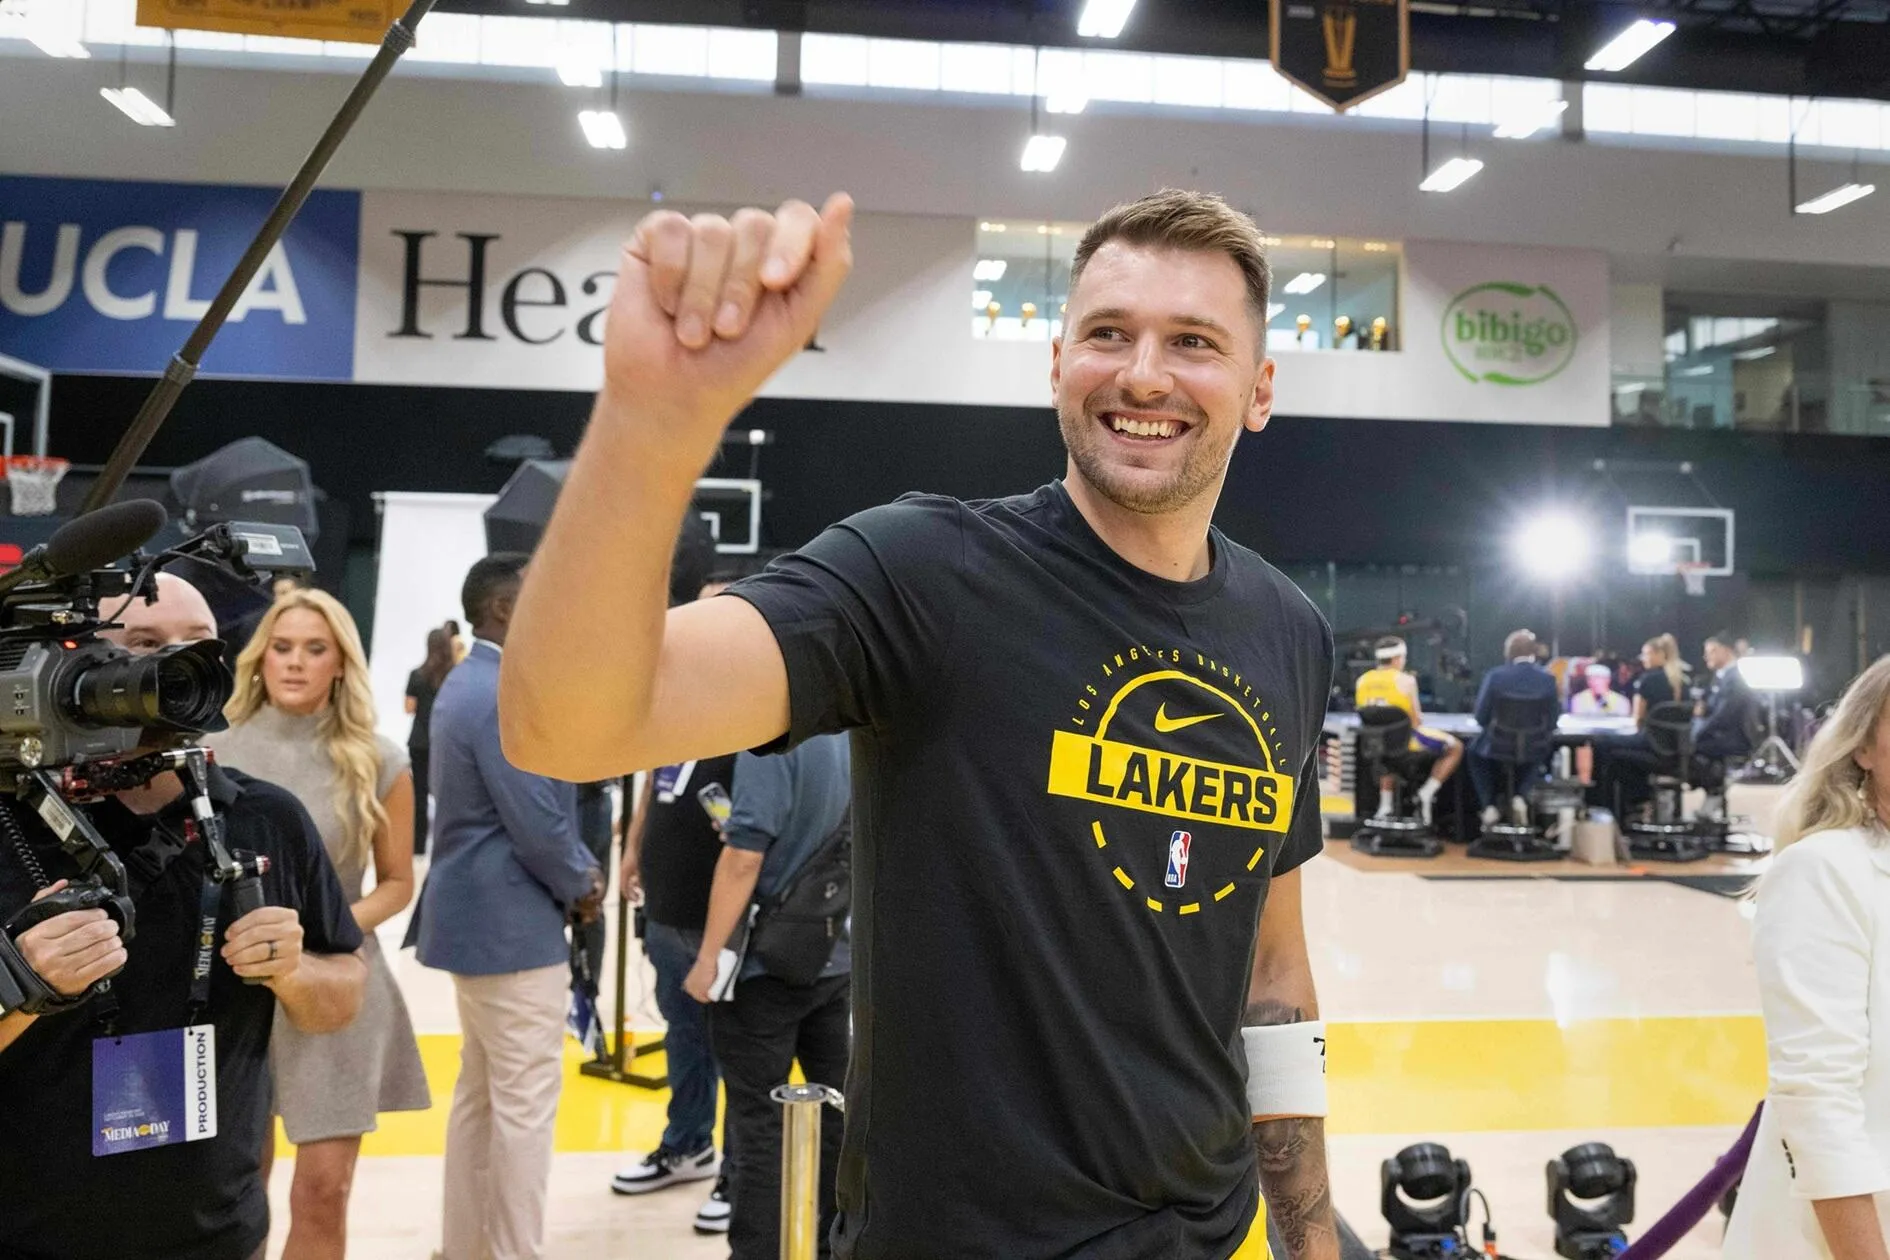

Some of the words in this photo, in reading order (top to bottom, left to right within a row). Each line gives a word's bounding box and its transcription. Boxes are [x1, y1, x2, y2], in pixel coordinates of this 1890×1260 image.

[0, 221, 307, 325] UCLA
[1455, 308, 1568, 359] bibigo
[1072, 684, 1098, 726] LOS
[1102, 645, 1180, 677] ANGEES
[1197, 653, 1287, 766] BASKETBALL
[1086, 742, 1278, 825] LAKERS
[197, 1032, 208, 1134] PRODUCTION
[101, 1125, 140, 1142] MEDIA
[150, 1120, 171, 1136] DAY
